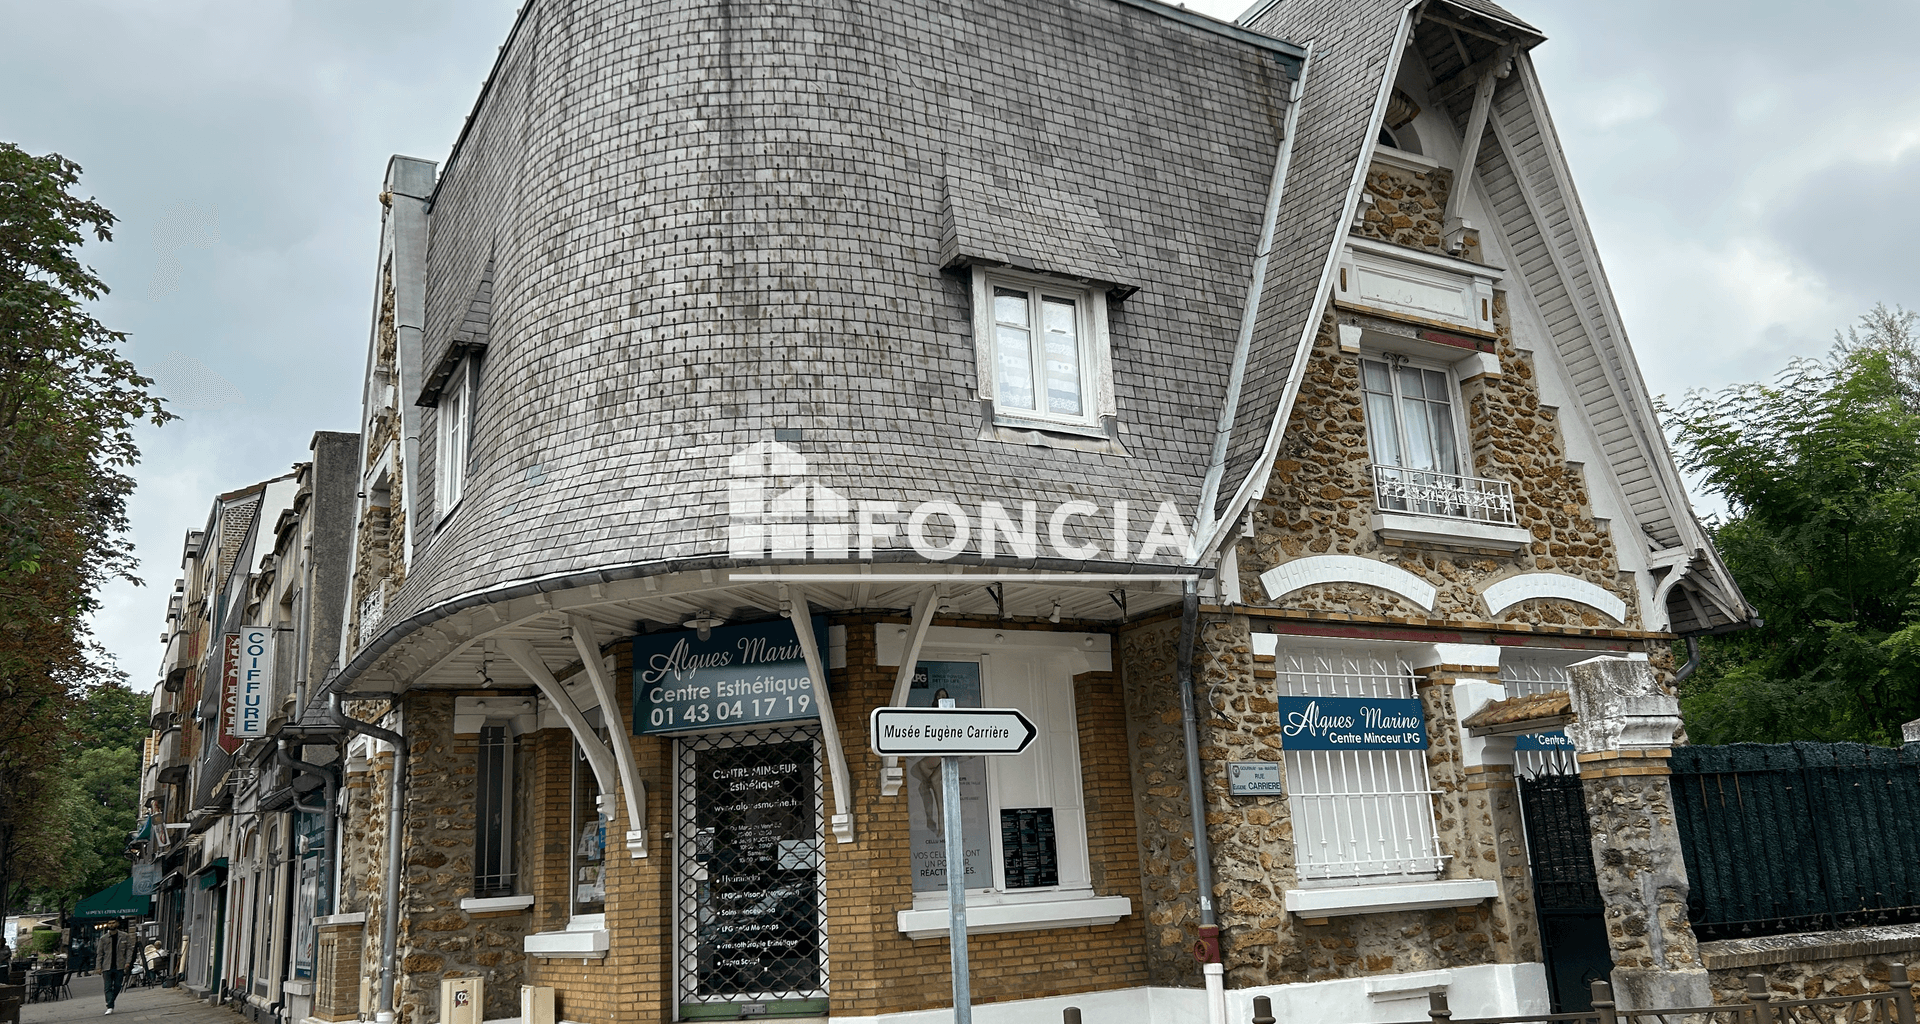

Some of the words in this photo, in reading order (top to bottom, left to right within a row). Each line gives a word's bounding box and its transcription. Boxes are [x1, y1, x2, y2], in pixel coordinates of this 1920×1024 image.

[642, 638, 733, 683] Algues
[737, 637, 808, 664] Marin
[243, 632, 265, 732] COIFFURE
[912, 673, 928, 683] LPG
[650, 684, 711, 704] Centre
[717, 676, 811, 697] Esthétique
[651, 707, 674, 727] 01
[683, 704, 710, 723] 43
[716, 701, 743, 721] 04
[752, 697, 777, 717] 17
[785, 695, 811, 714] 19
[1283, 700, 1355, 737] Algues
[1359, 706, 1420, 729] Marine
[884, 724, 920, 738] Musée
[924, 725, 963, 741] Eugène
[967, 725, 1009, 738] Carrière
[1329, 732, 1362, 743] Centre
[1364, 732, 1401, 743] Minceur
[1403, 732, 1420, 743] LPG
[1538, 734, 1566, 745] Centre
[751, 763, 797, 776] MINCEUR
[1248, 782, 1280, 790] CARRIERE
[913, 852, 928, 860] VOS
[966, 849, 980, 857] ONT
[938, 859, 971, 867] POIR.
